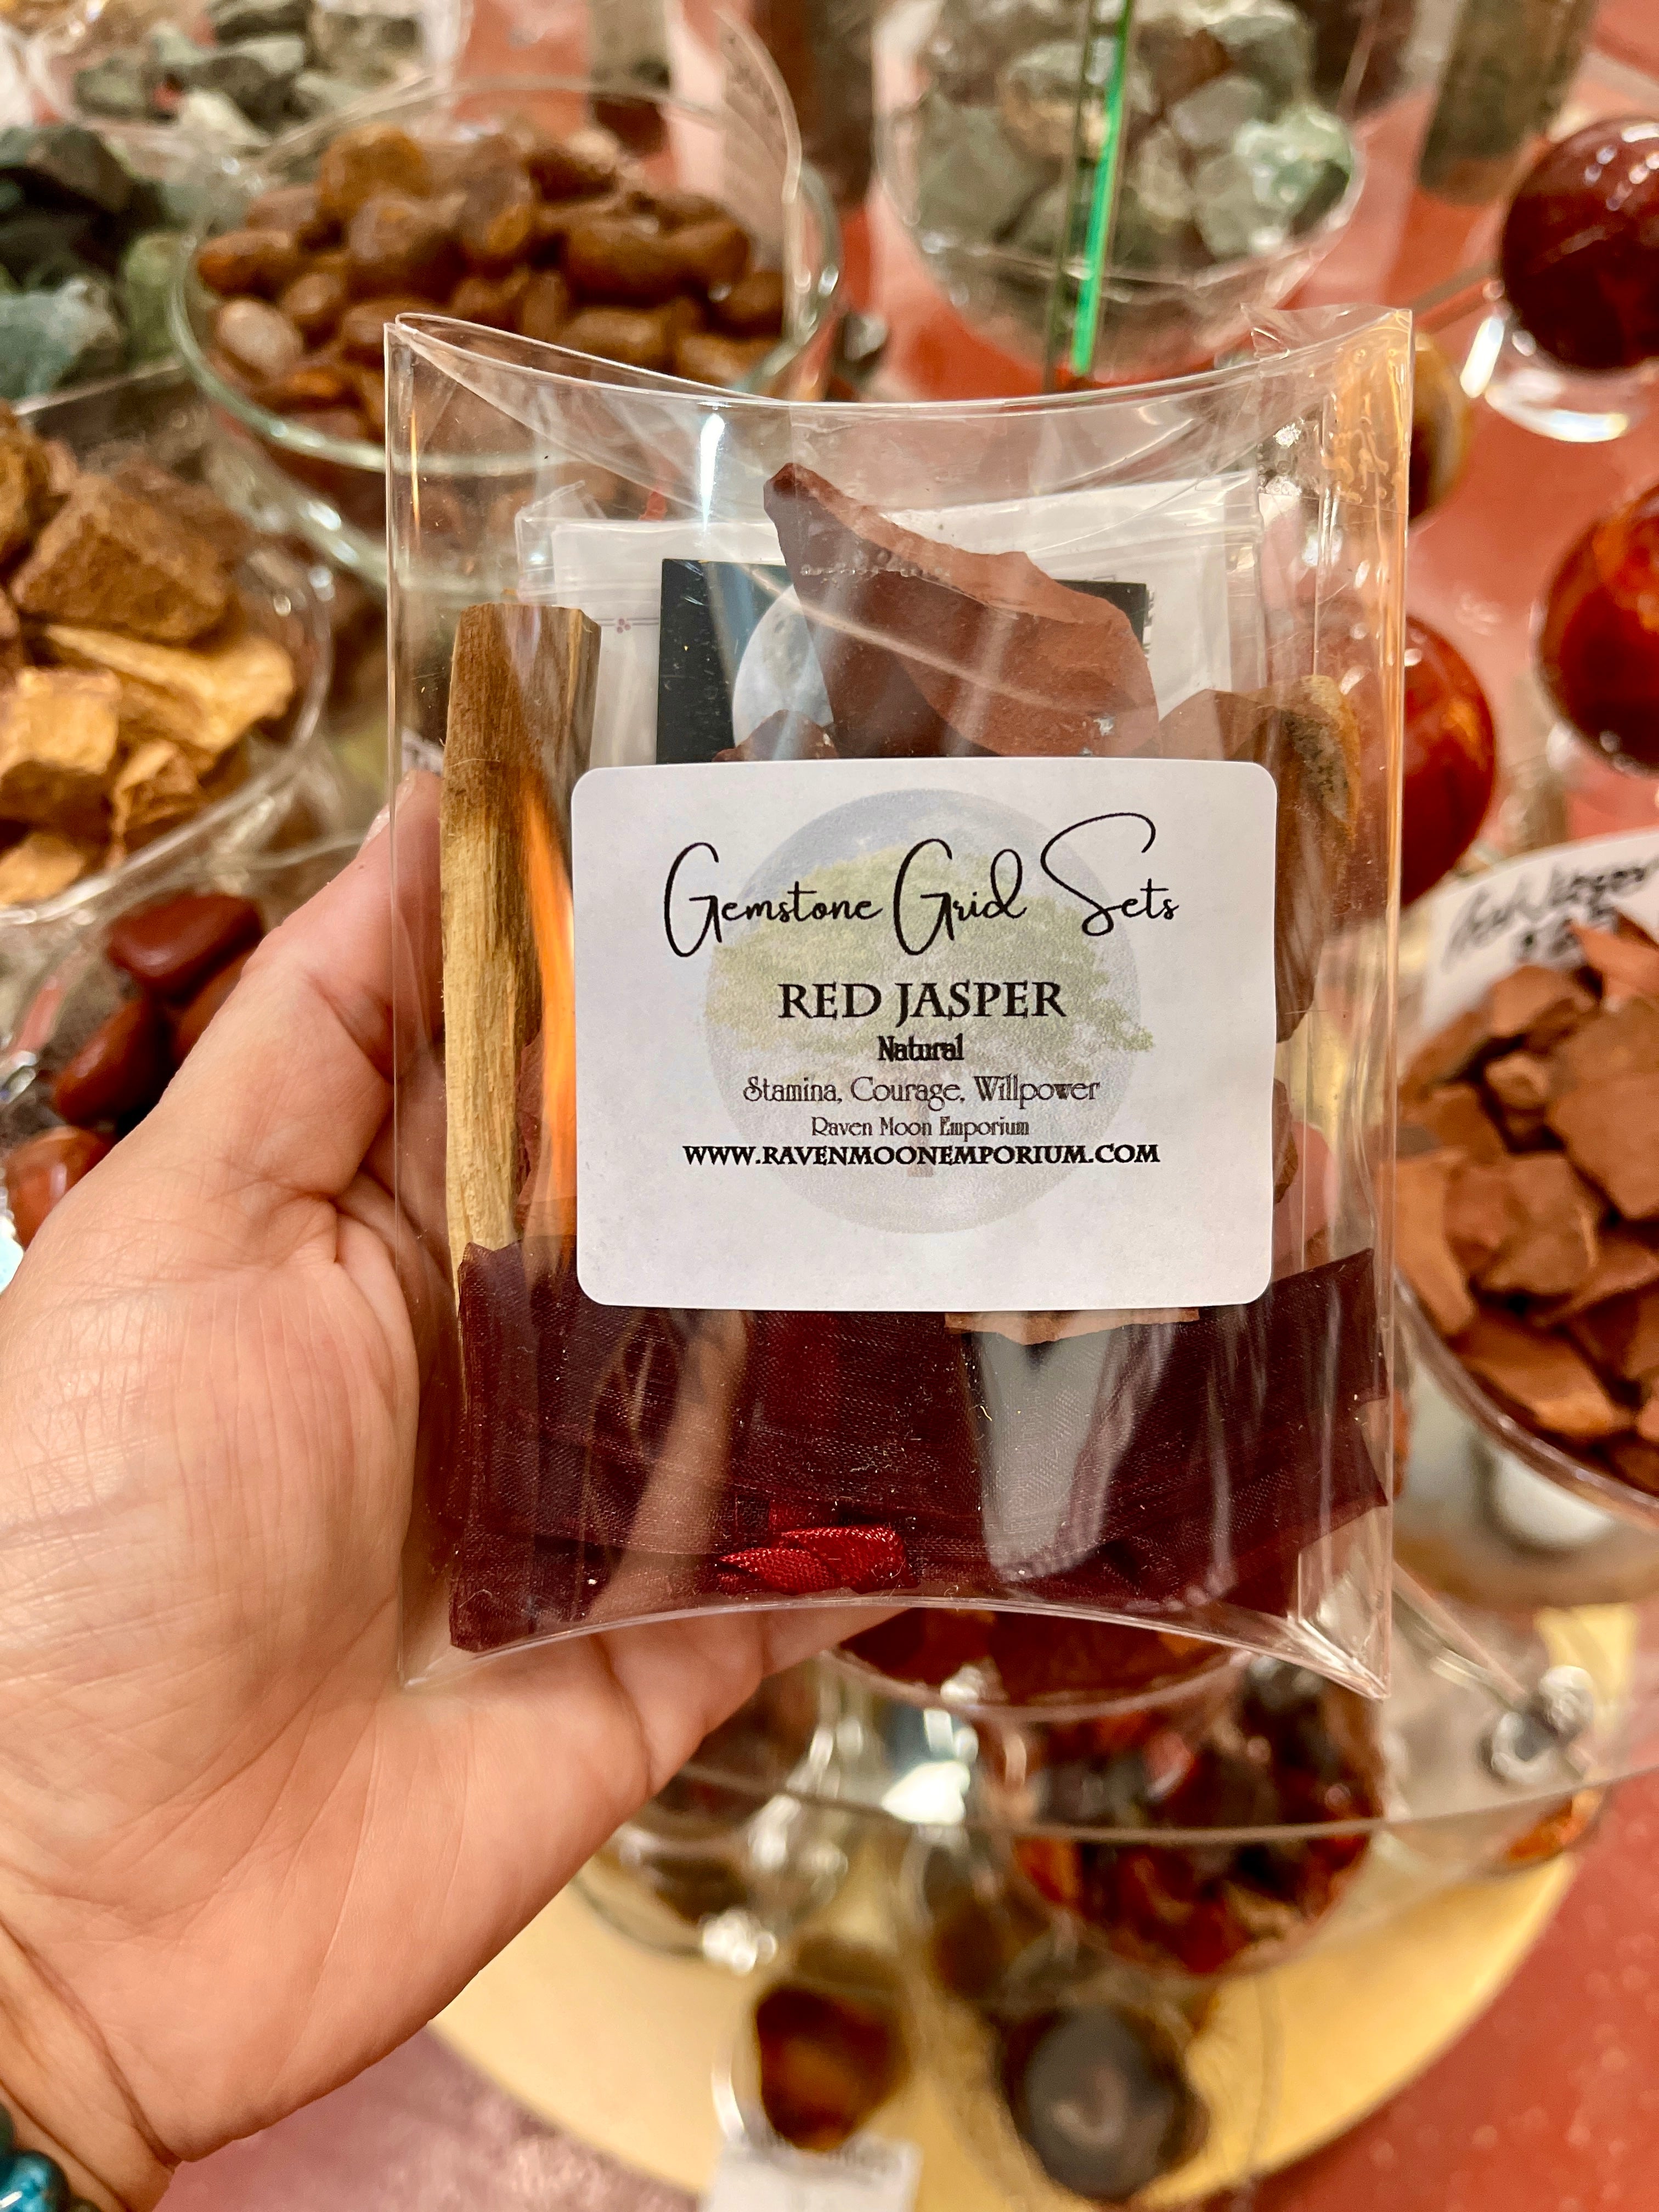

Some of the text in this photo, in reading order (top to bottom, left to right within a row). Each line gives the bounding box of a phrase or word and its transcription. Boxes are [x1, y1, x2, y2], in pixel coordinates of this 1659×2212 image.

[664, 812, 1180, 957] Gemstone Grid Sets
[778, 980, 1067, 1028] RED JASPER
[877, 1034, 965, 1062] Natural
[743, 1074, 1101, 1111] Stamina, Courage, Willpower
[811, 1116, 1030, 1142] Raven Moon Emporium
[682, 1143, 1161, 1166] WWW.RAVENMOONEMPORIUM.COM
